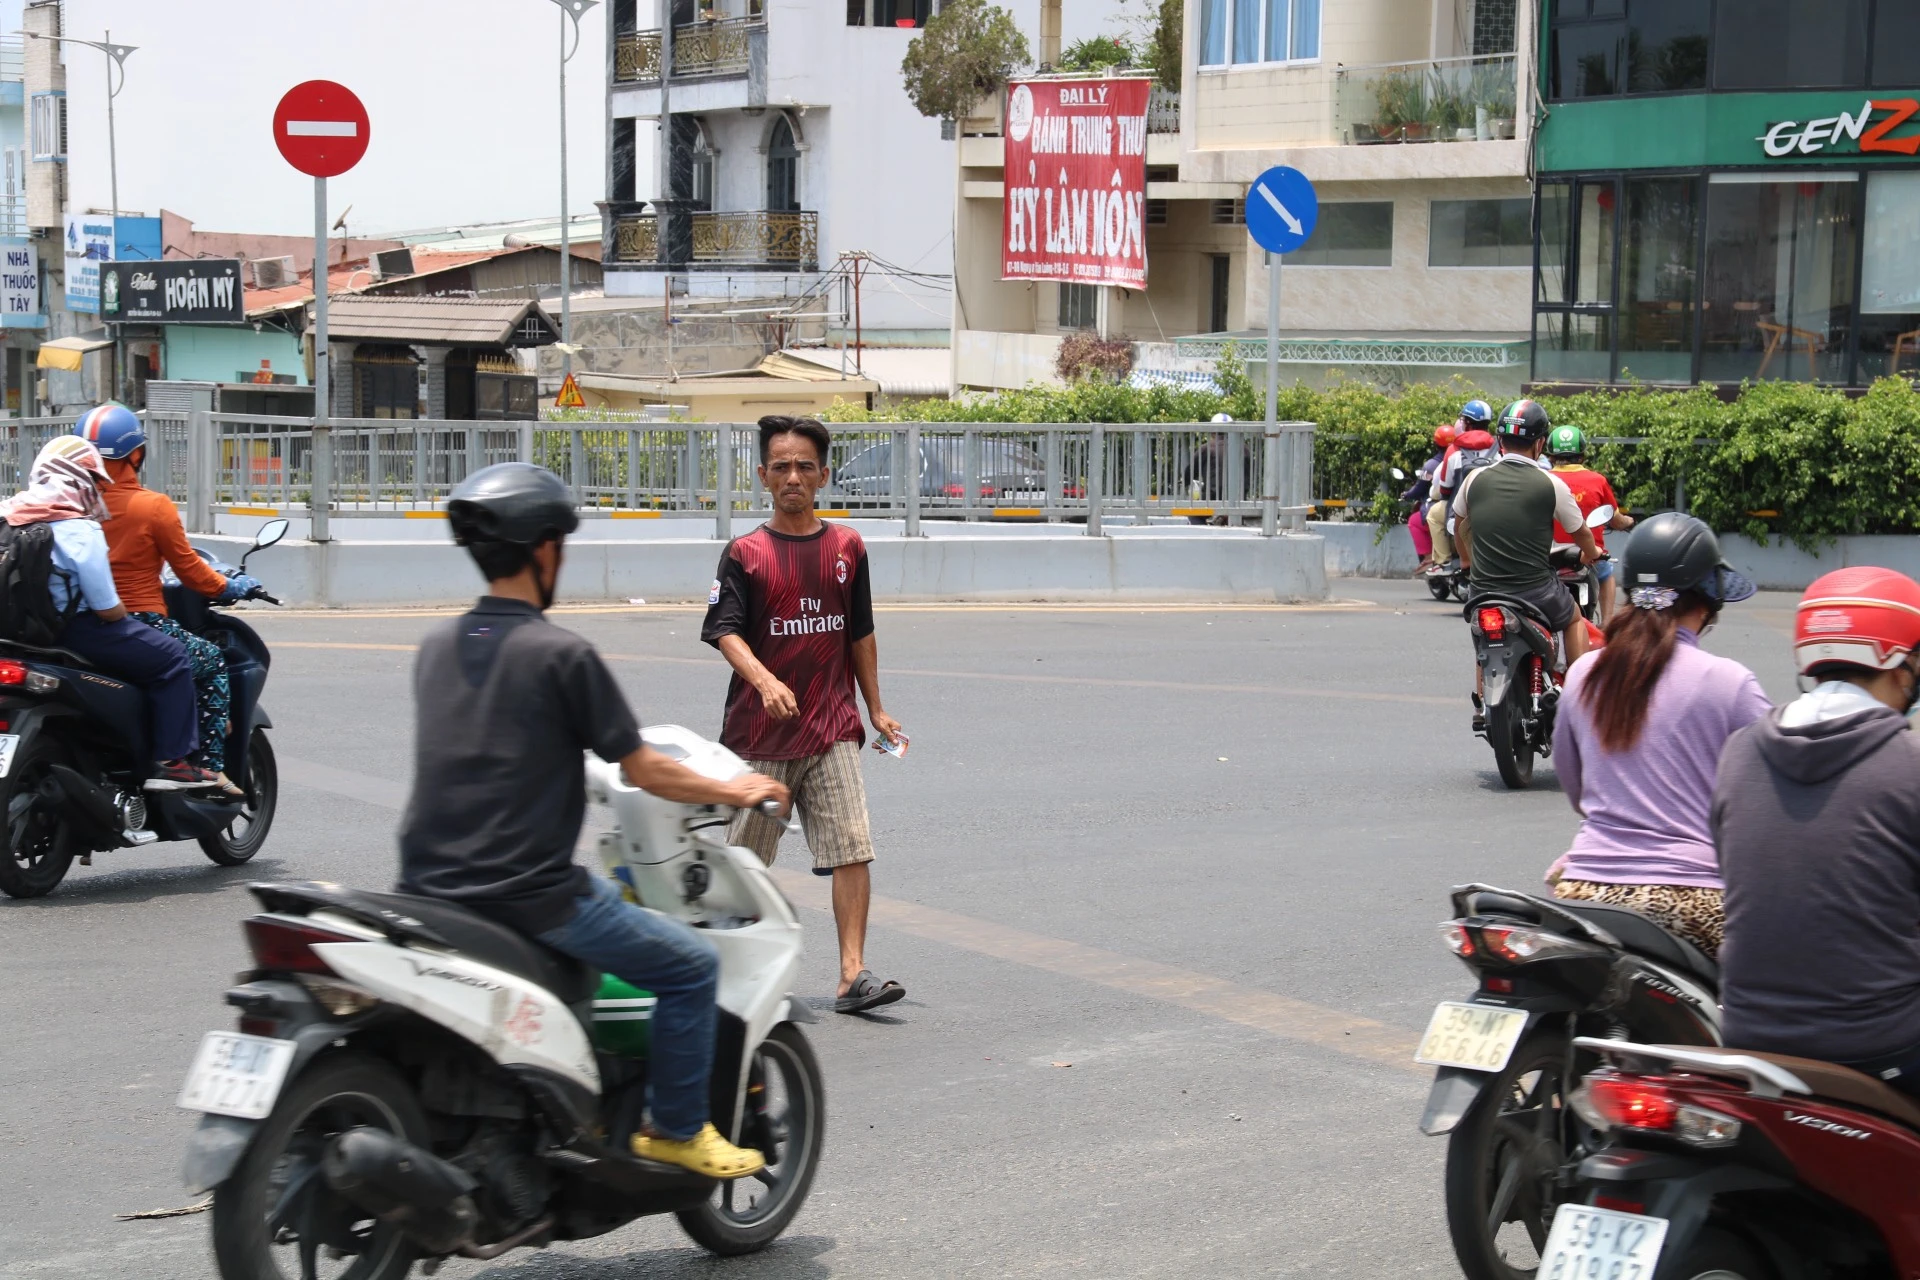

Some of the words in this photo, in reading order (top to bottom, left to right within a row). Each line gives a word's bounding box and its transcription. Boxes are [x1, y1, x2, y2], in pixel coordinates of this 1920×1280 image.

[1060, 88, 1084, 105] ĐẠI
[1089, 84, 1109, 103] LÝ
[1032, 108, 1068, 154] BÁNH
[1071, 115, 1112, 155] TRUNG
[1116, 115, 1145, 156] THU
[1044, 167, 1089, 254] LÂM
[7, 248, 30, 266] NHÀ
[2, 269, 36, 289] THUỐC
[165, 269, 210, 312] HOÀN
[9, 293, 30, 312] TÂY
[800, 597, 821, 613] Fly
[769, 613, 845, 636] Emirates
